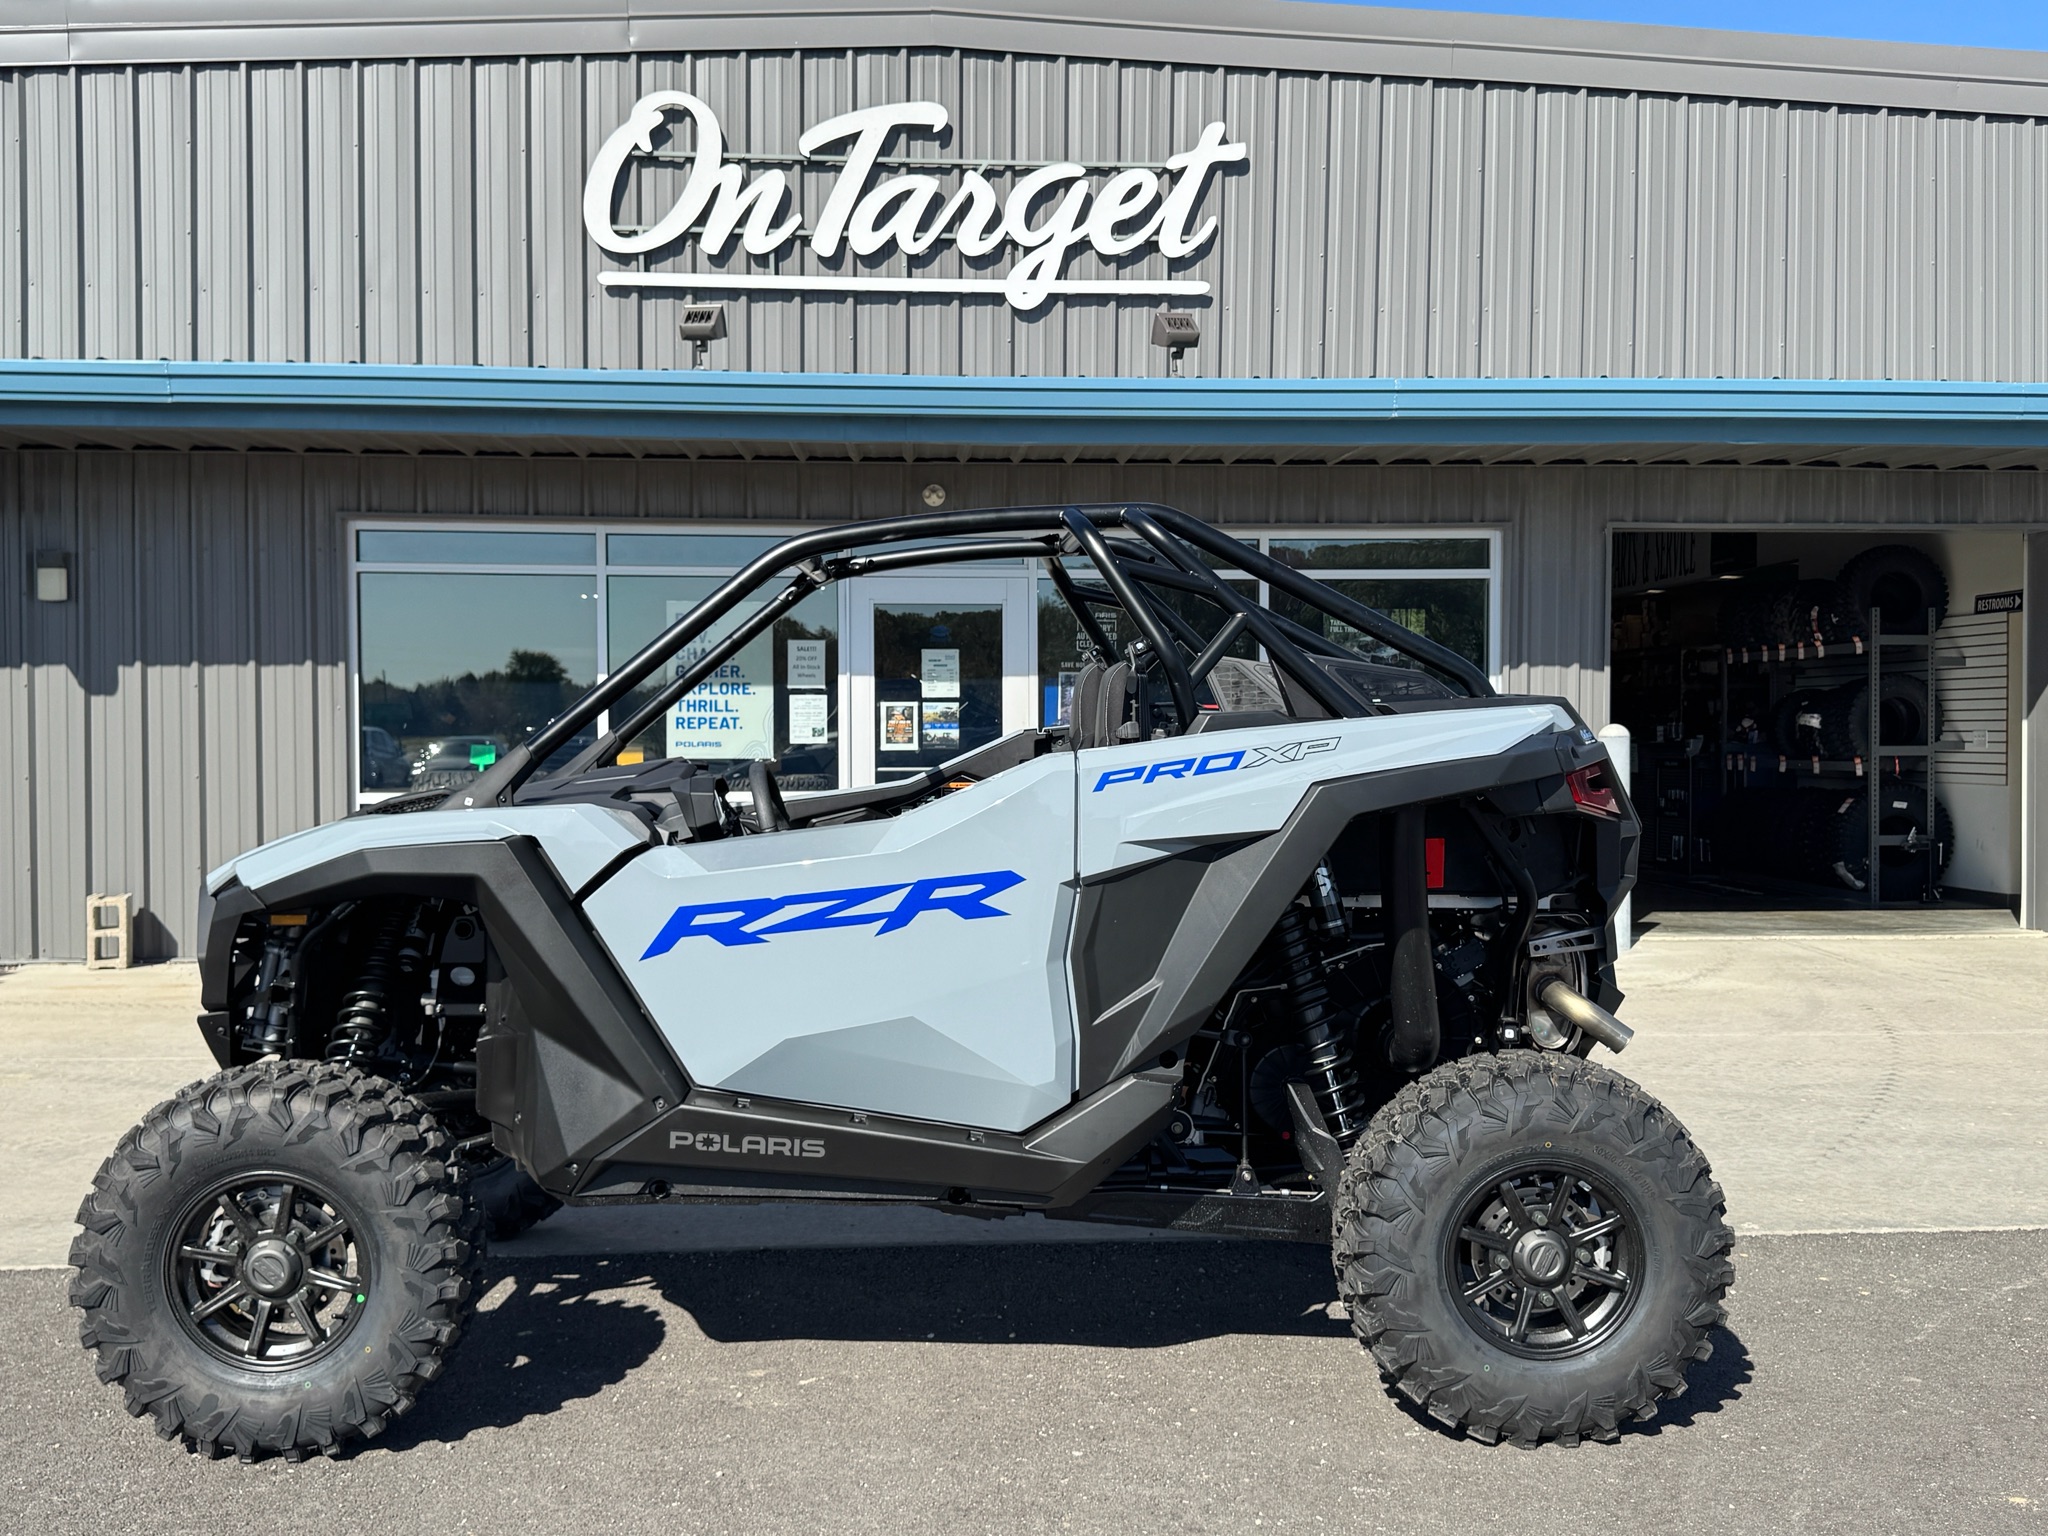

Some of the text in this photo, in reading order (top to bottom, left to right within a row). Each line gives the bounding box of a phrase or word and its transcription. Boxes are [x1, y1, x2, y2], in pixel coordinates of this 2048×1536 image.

[583, 89, 1248, 311] On Target
[1977, 596, 2014, 612] RESTROOMS
[677, 700, 739, 712] THRILL.
[675, 717, 743, 730] REPEAT.
[1092, 736, 1342, 793] PRO XP
[638, 870, 1027, 962] RZR
[669, 1131, 826, 1158] POLARIS
